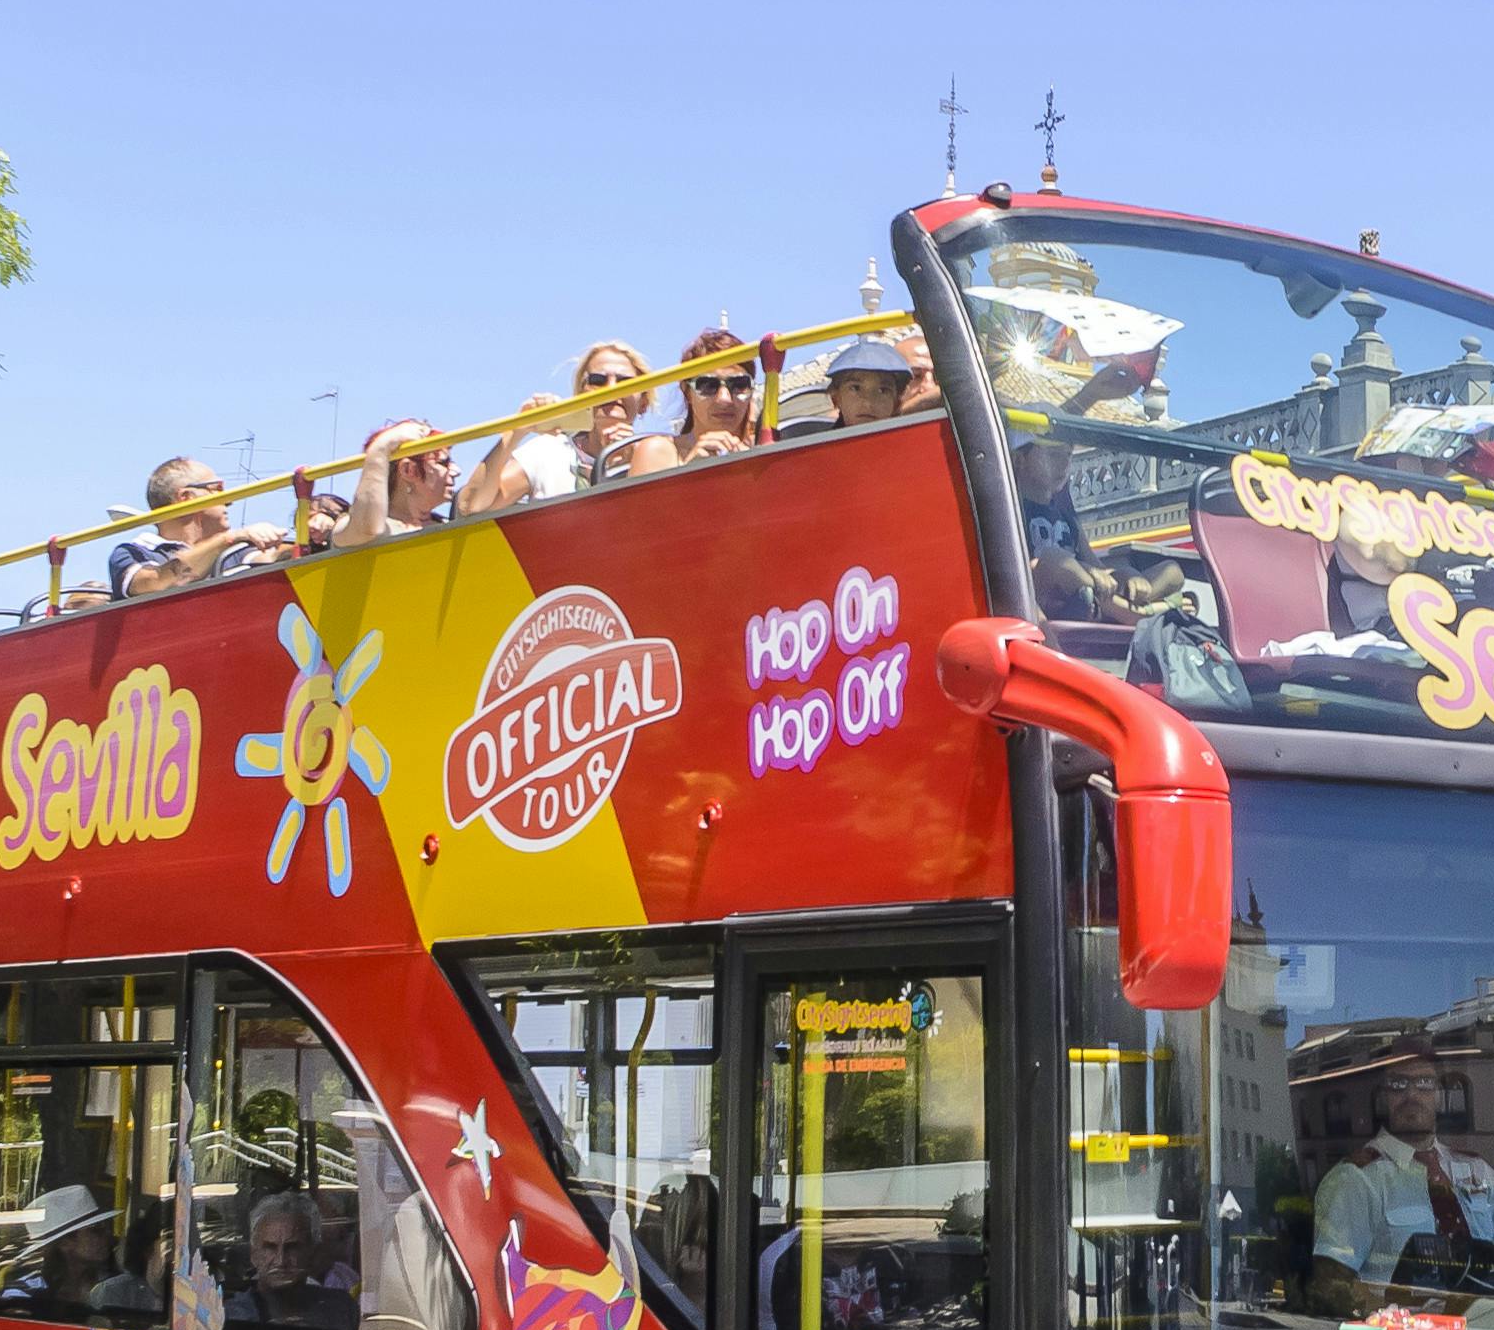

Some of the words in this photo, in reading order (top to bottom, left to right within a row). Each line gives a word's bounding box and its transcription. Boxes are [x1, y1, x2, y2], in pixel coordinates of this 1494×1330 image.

[495, 604, 617, 692] CITYSIGHTSEEING
[751, 607, 827, 680] Hop
[838, 575, 894, 646] On
[465, 652, 666, 799] OFFICIAL
[753, 696, 830, 768] Hop
[842, 651, 905, 736] Off
[0, 675, 196, 860] Sevilla
[522, 750, 614, 830] TOUR
